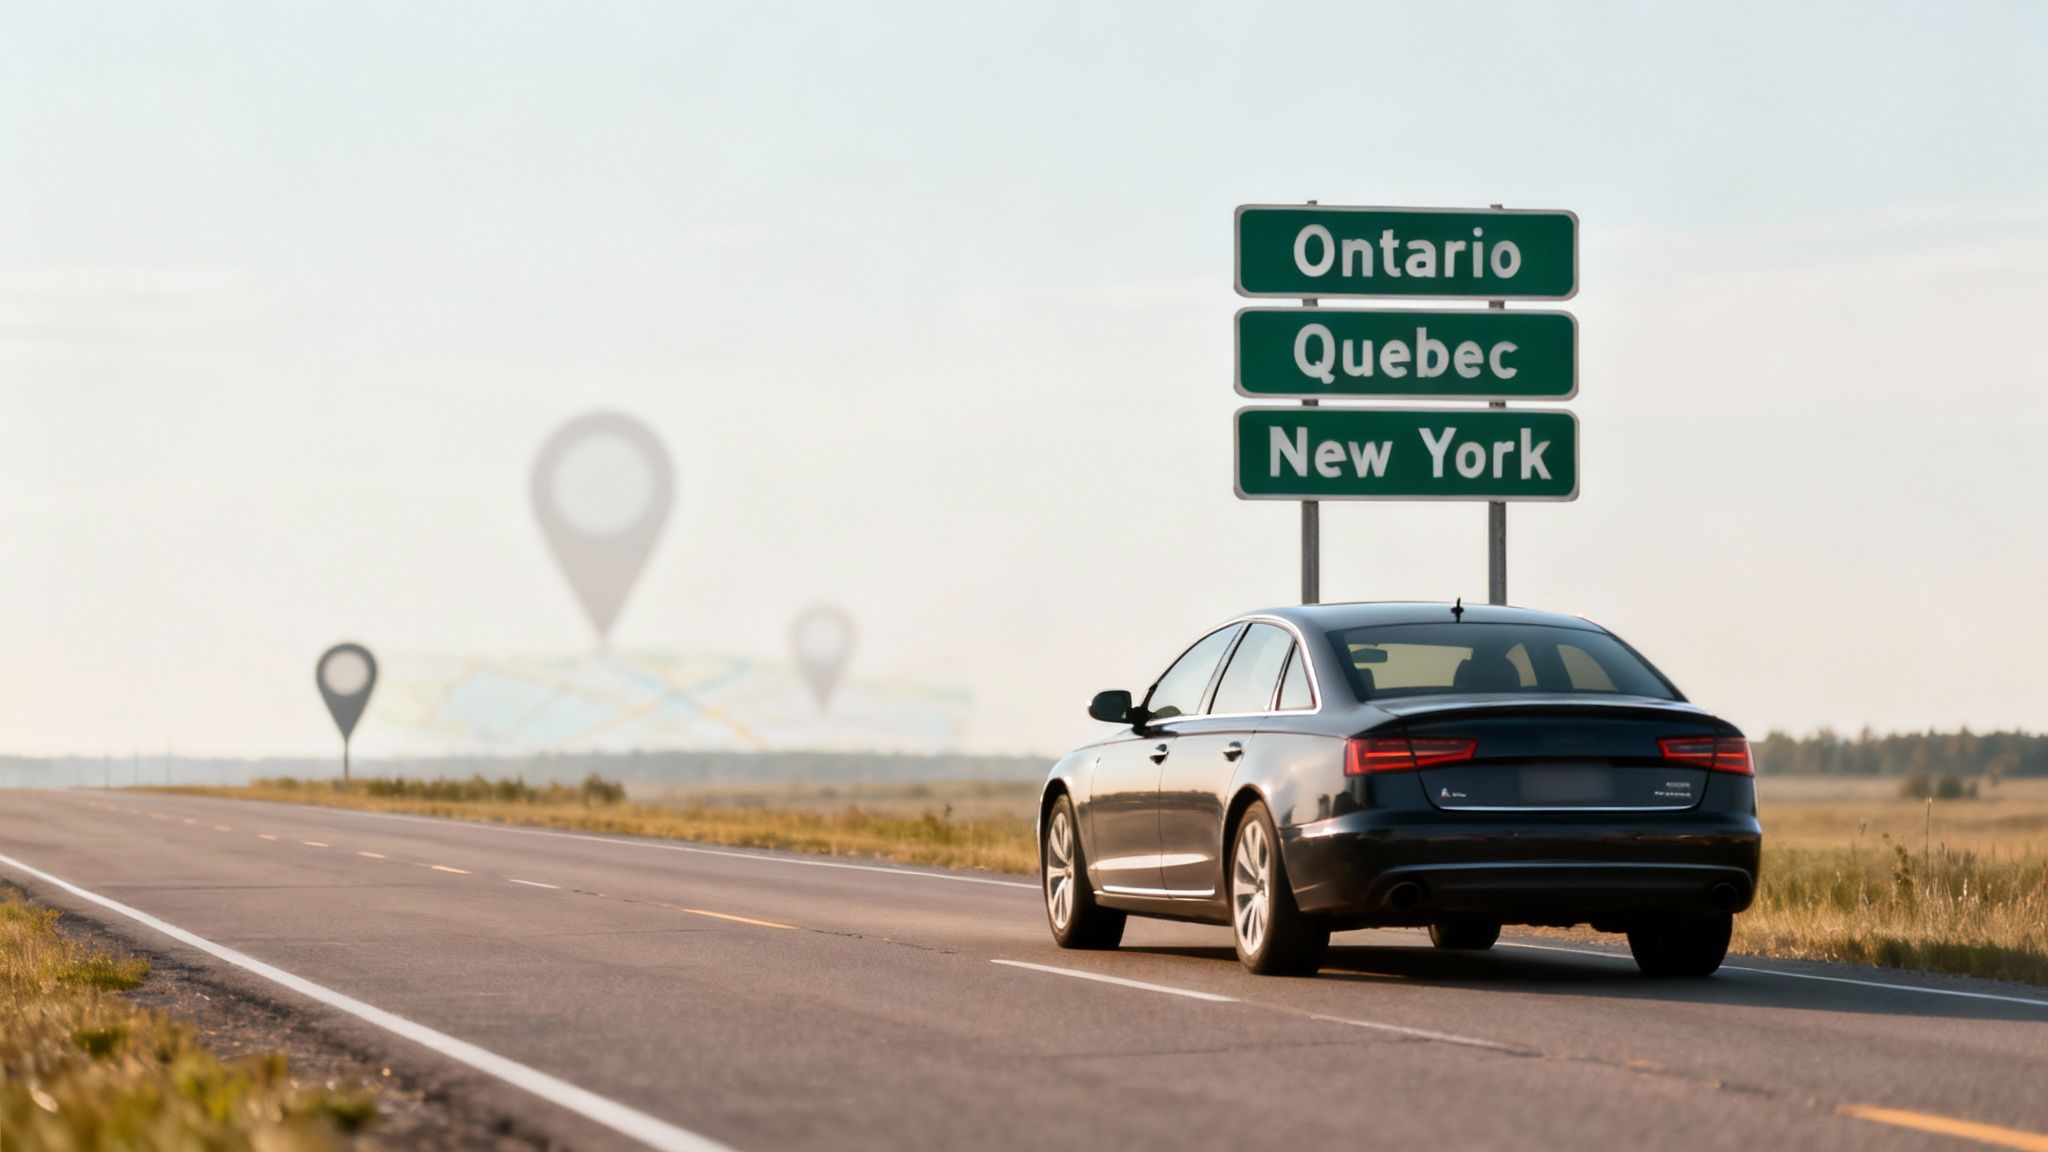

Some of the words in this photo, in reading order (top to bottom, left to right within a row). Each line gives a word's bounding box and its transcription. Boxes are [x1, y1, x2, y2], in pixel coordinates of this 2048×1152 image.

[1293, 224, 1522, 278] Ontario
[1293, 323, 1518, 384] Quebec
[1270, 426, 1392, 478] New
[1419, 427, 1551, 479] York
